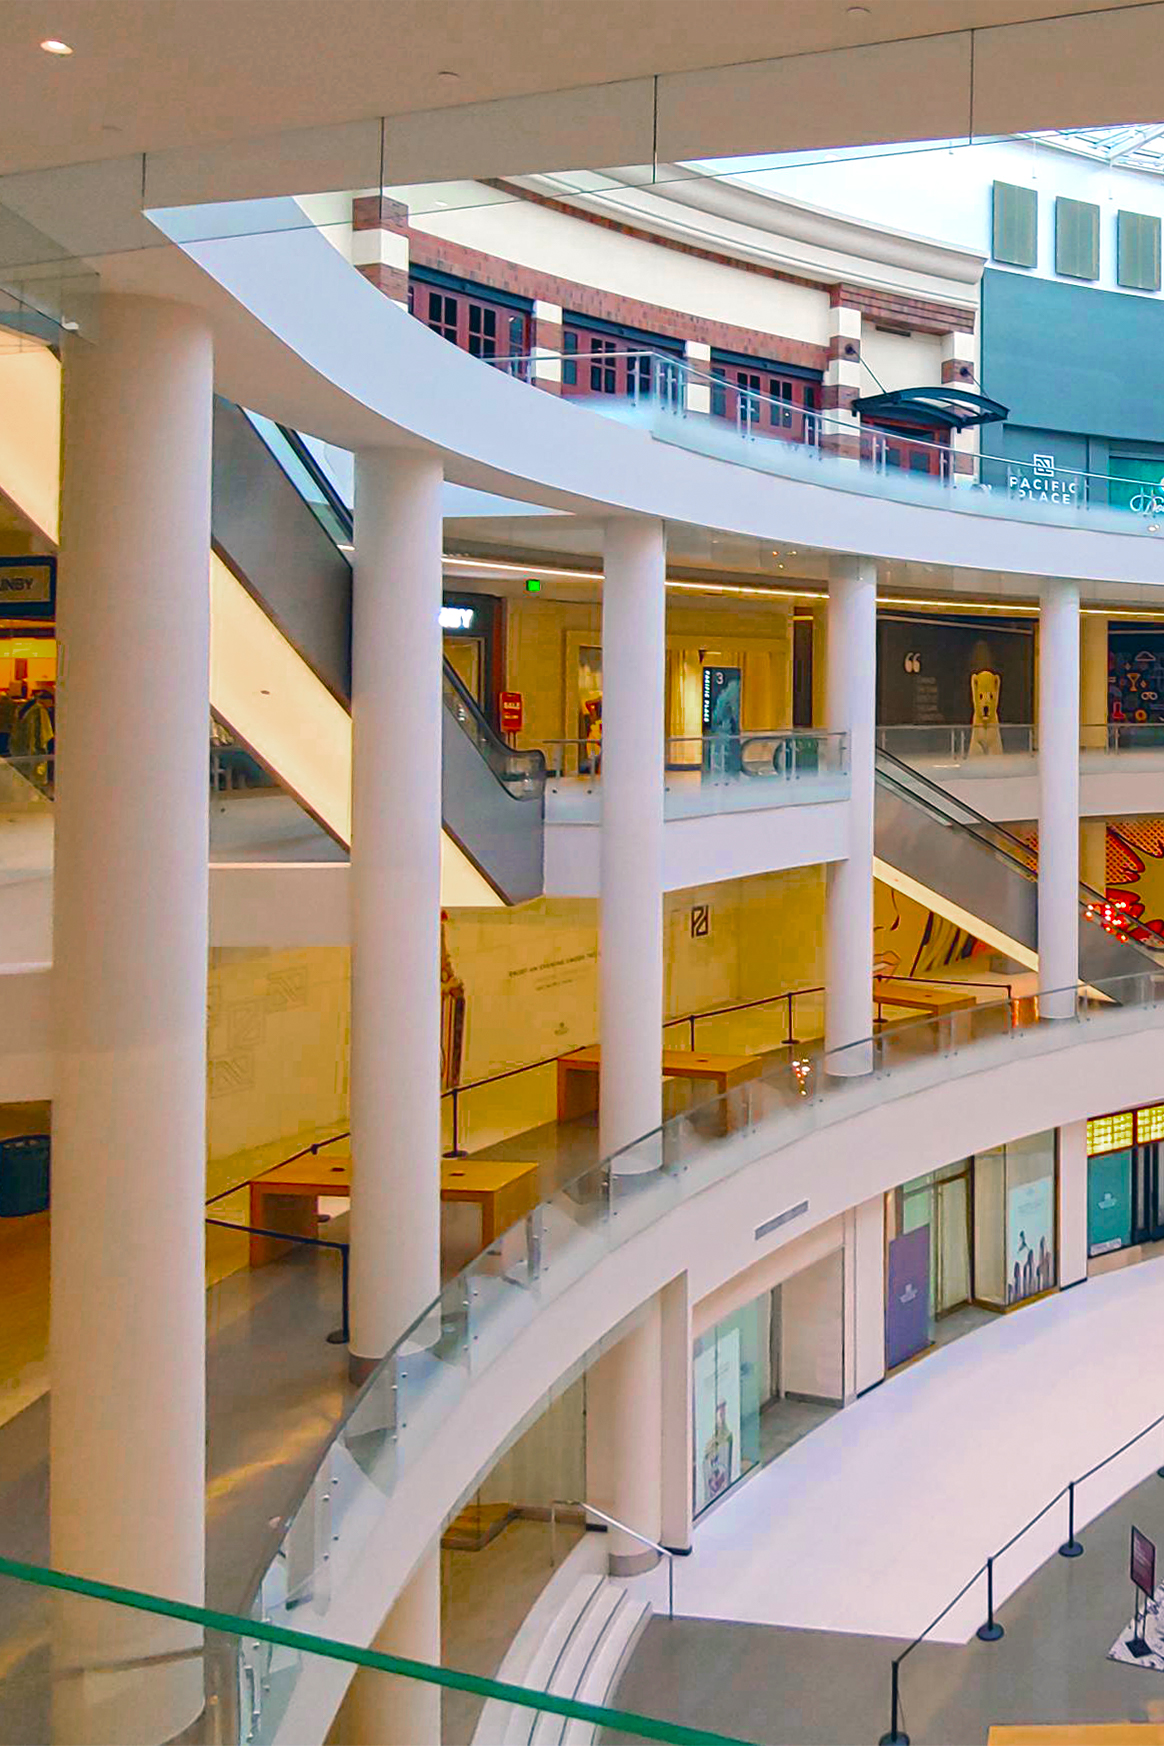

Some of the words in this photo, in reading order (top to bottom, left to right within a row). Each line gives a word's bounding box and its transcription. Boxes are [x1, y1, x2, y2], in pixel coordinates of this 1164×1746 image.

[1010, 477, 1077, 494] PACIFIC
[1019, 489, 1071, 505] PLACE
[716, 672, 724, 685] 3
